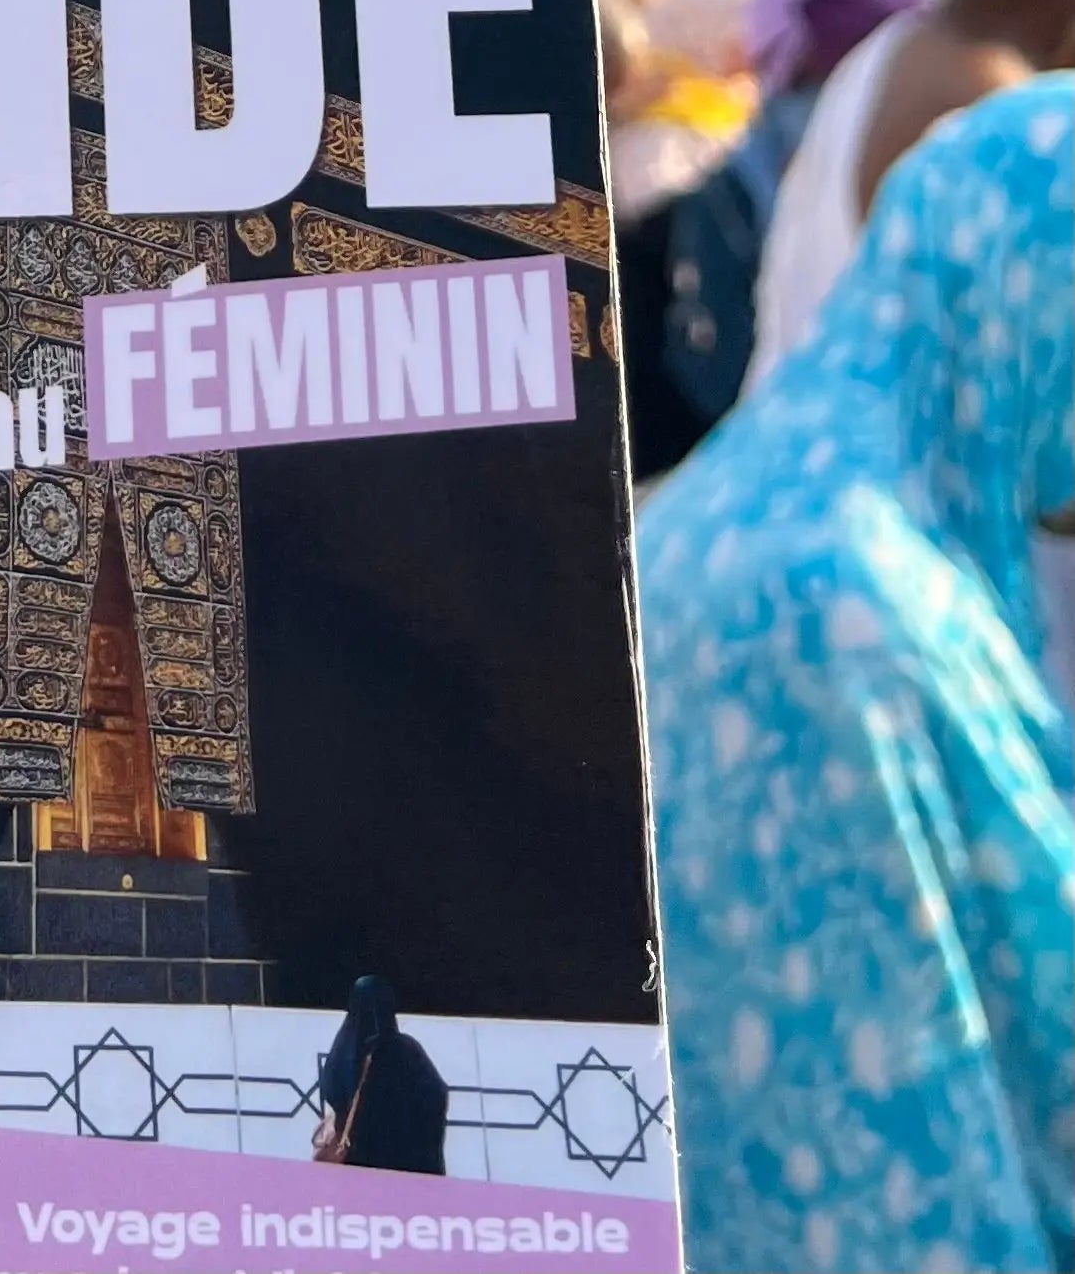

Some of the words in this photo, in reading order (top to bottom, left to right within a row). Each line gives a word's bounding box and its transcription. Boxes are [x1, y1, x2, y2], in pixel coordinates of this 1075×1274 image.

[102, 262, 557, 444] FÉMININ
[17, 1202, 221, 1260] Voyage
[241, 1204, 629, 1260] indispensable
